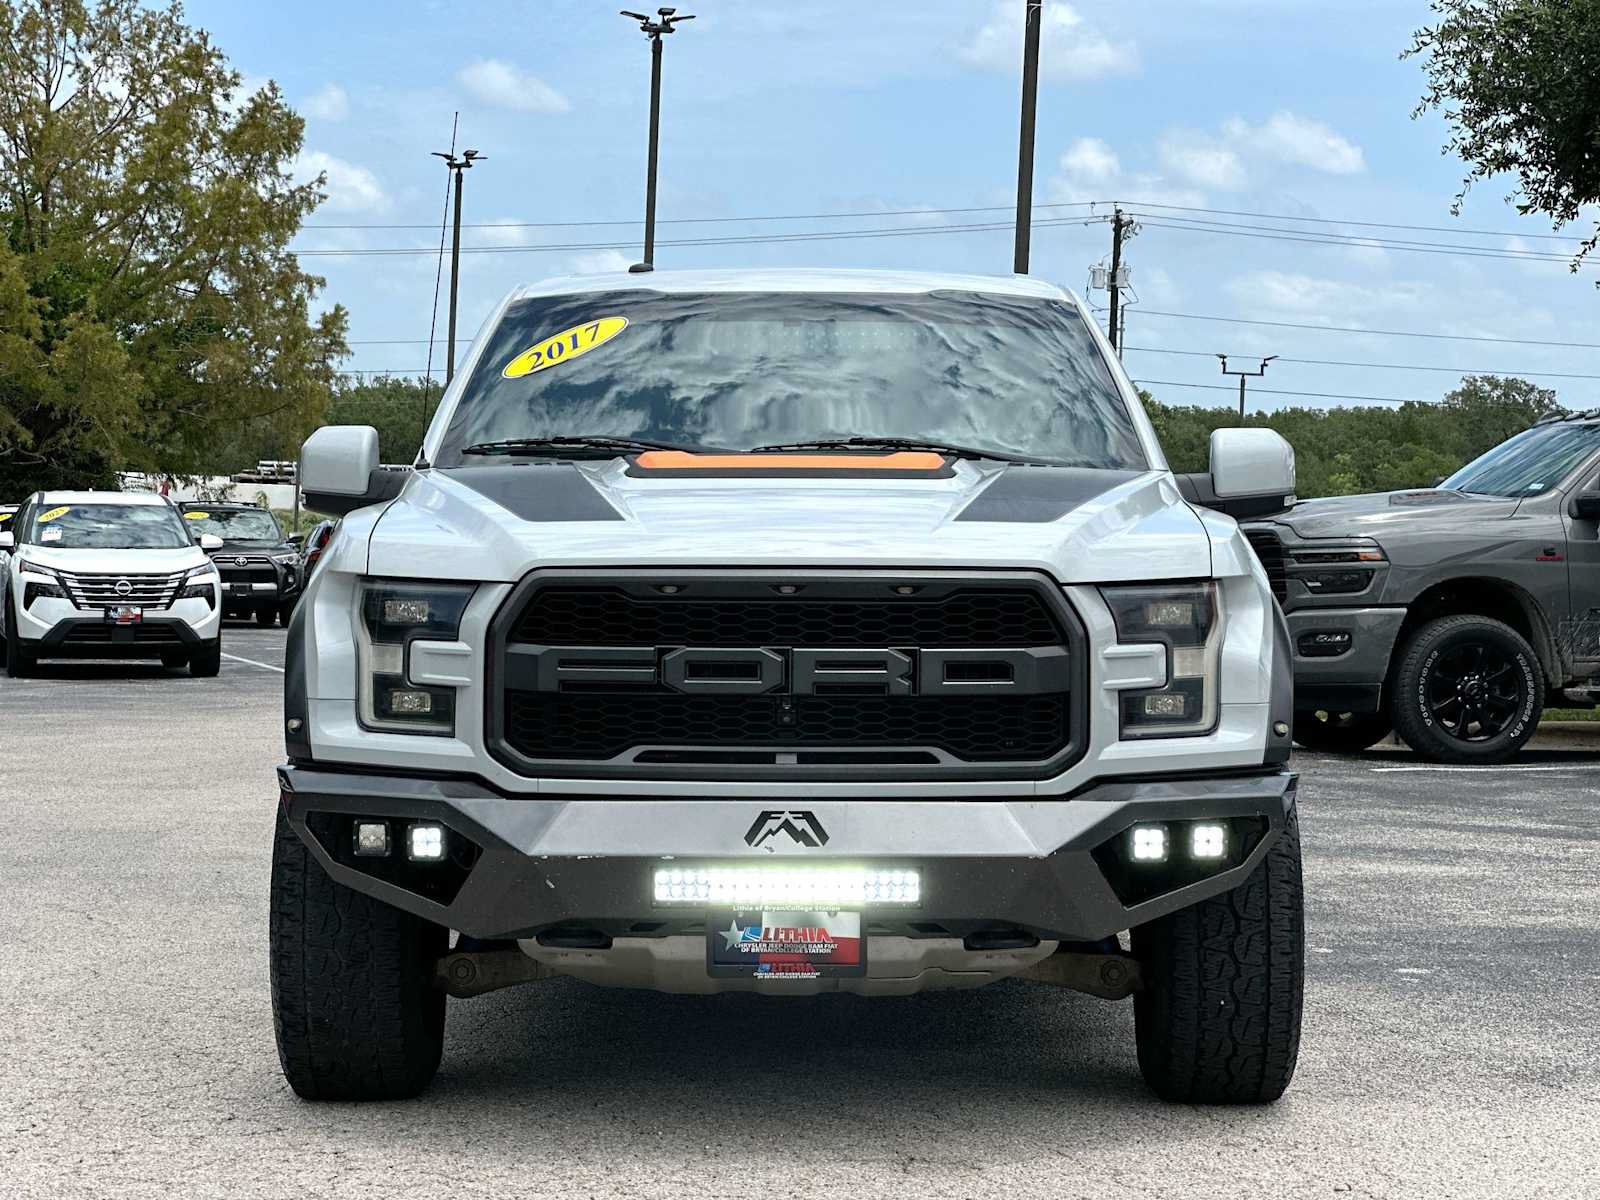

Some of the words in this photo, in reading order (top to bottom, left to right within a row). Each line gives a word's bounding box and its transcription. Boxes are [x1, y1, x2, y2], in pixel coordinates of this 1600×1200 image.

[527, 322, 601, 371] 2017
[537, 646, 1026, 696] FORD
[761, 927, 834, 943] LITHIA
